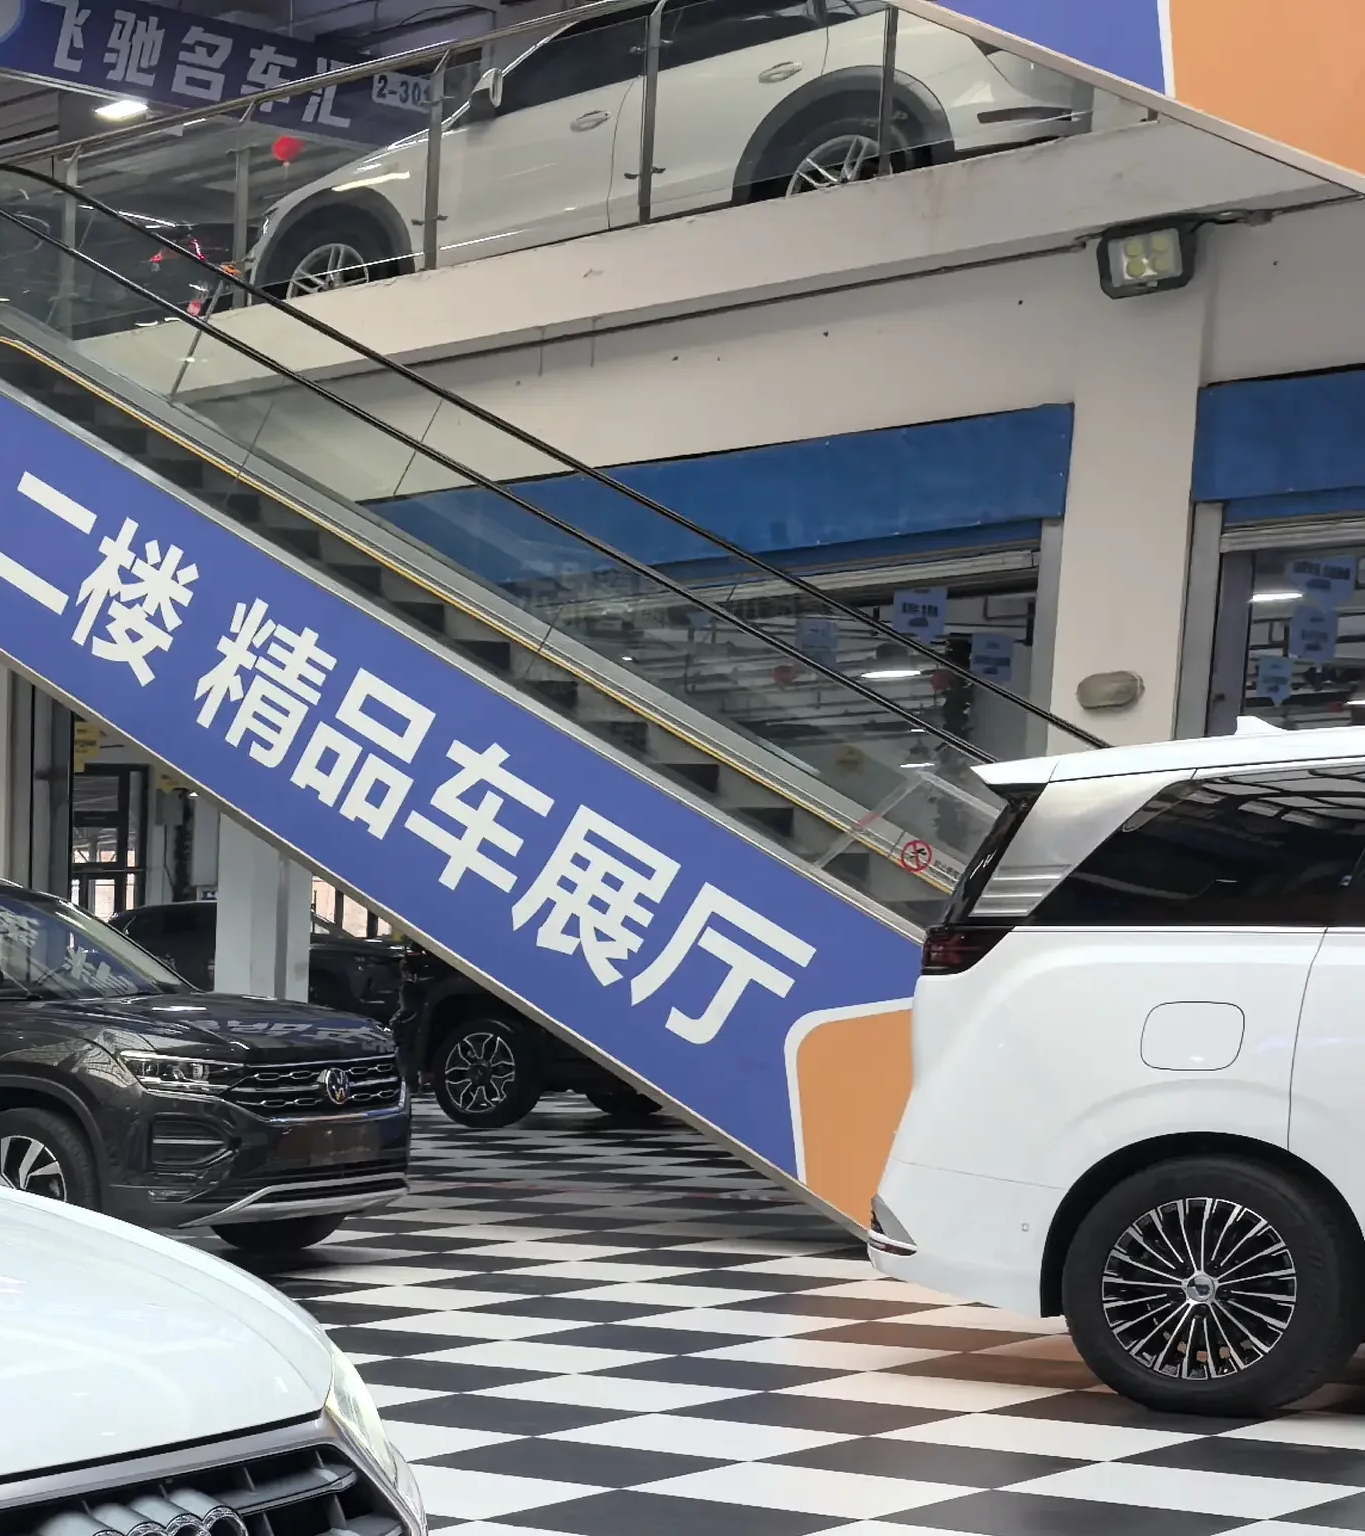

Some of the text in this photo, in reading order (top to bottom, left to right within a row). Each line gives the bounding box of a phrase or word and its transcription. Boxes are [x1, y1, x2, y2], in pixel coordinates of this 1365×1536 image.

[194, 597, 817, 1045] 精品车展厅
